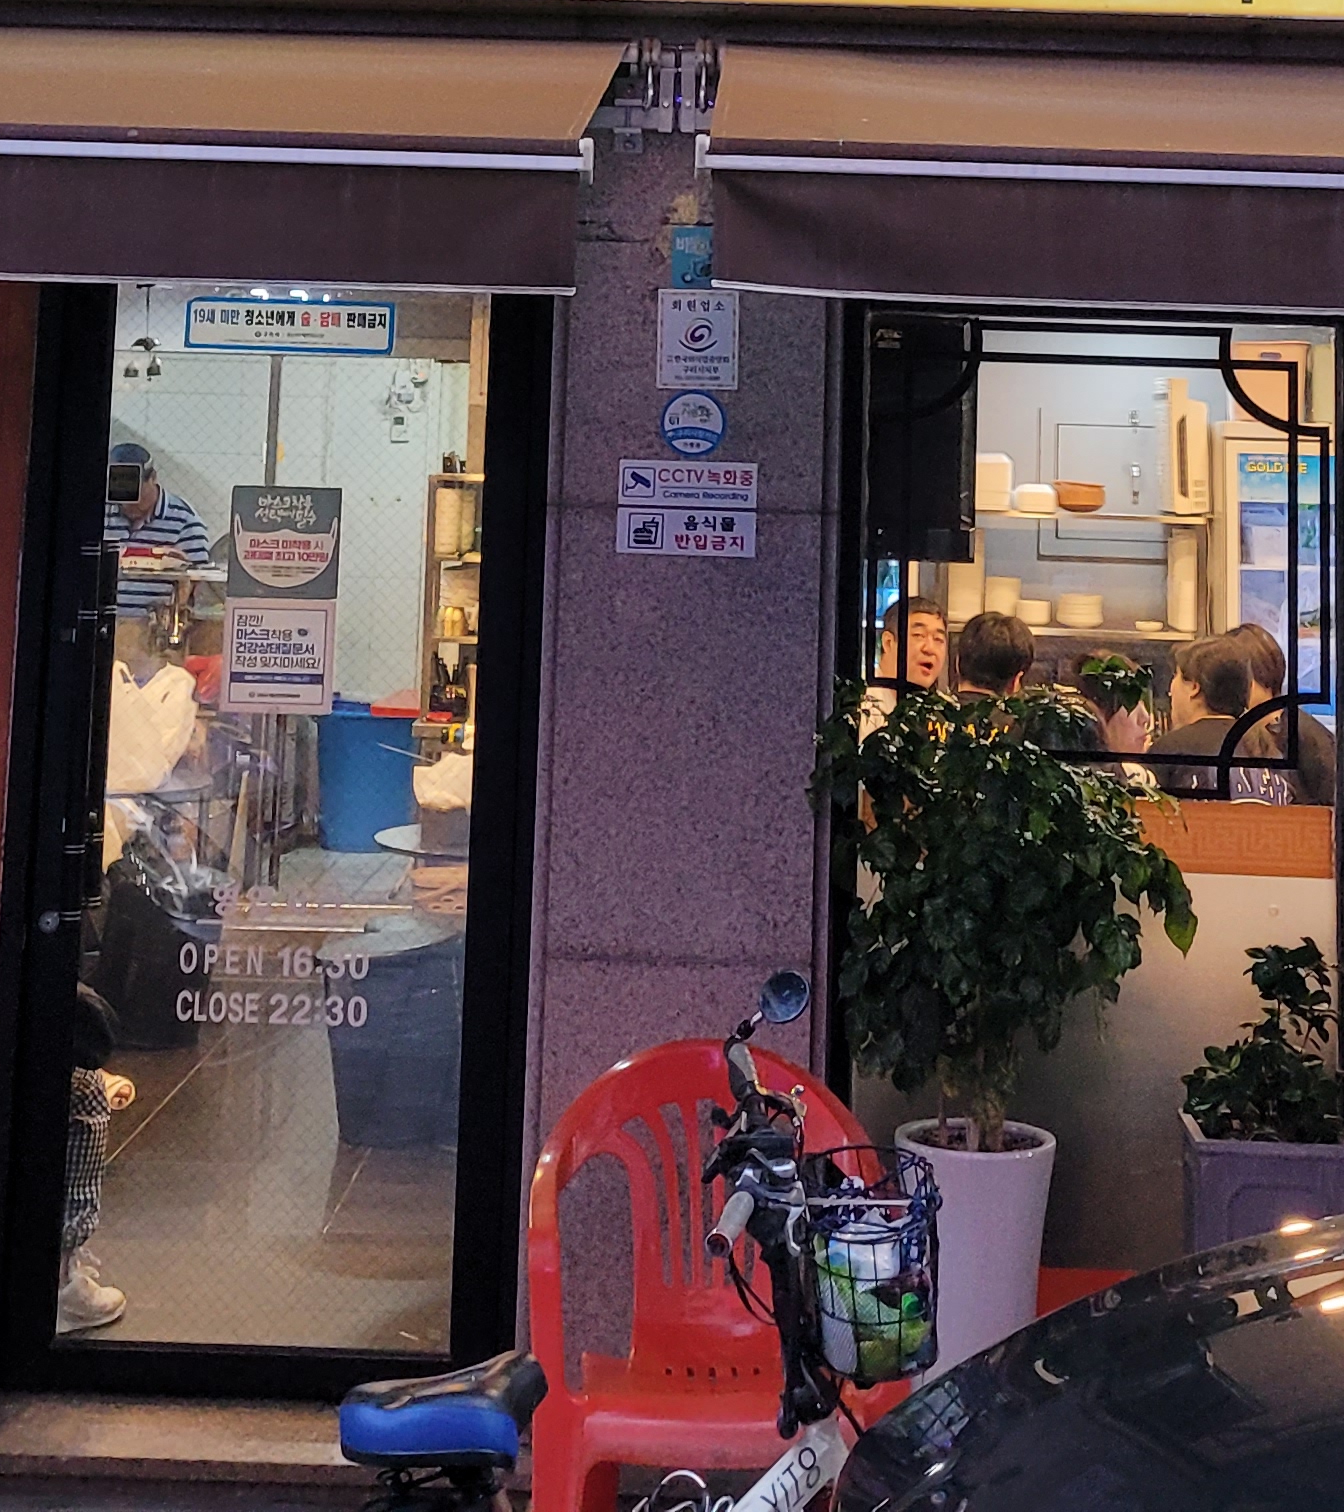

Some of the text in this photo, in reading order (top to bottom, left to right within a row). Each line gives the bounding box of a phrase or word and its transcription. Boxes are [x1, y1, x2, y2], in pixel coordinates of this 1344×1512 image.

[663, 490, 700, 499] Camera
[683, 514, 736, 532] 음식물
[674, 534, 744, 551] 반입금지
[179, 942, 263, 977] OPEN
[176, 989, 368, 1027] CLOSE 22:30
